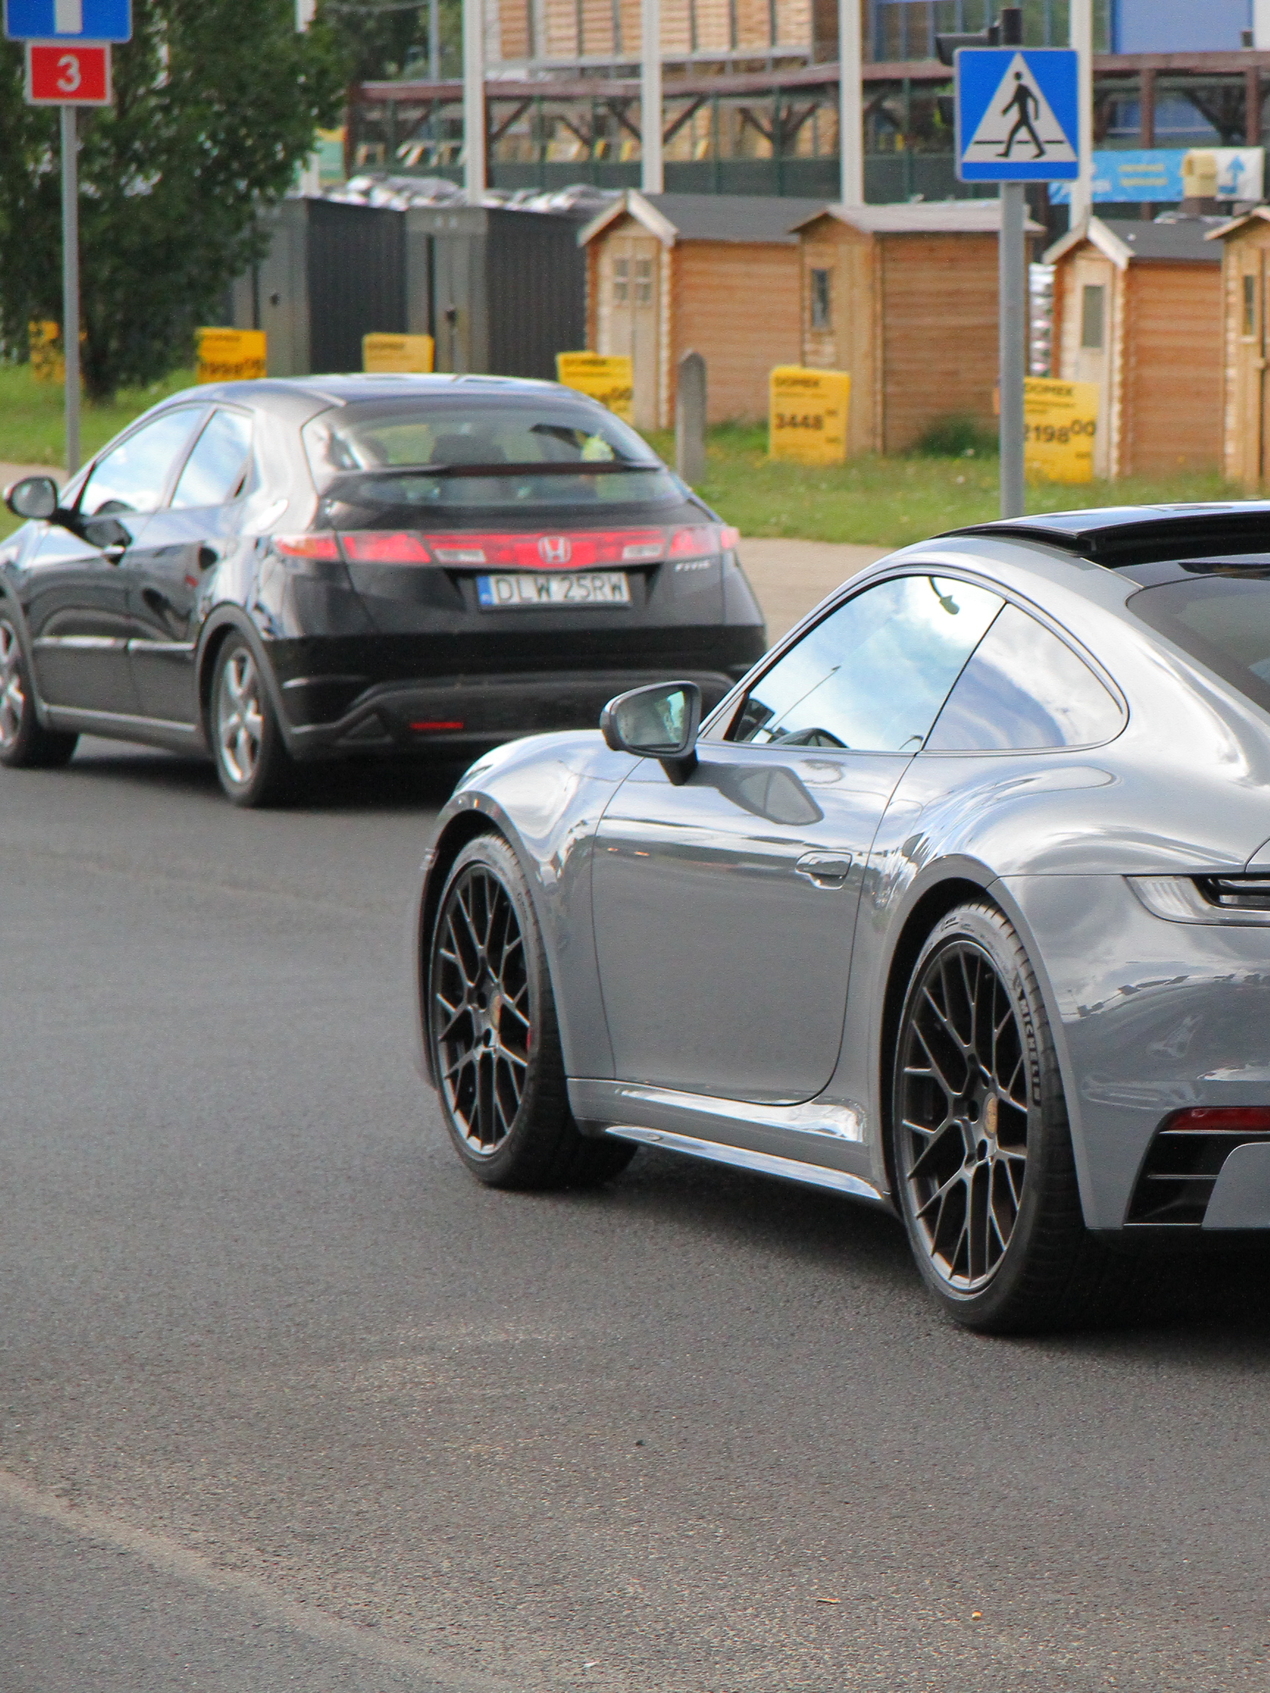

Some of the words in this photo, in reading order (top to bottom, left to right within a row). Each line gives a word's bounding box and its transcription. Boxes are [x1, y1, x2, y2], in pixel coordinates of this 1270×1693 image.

[57, 54, 81, 92] 3
[495, 576, 550, 602] DLW
[560, 573, 623, 601] 25RW
